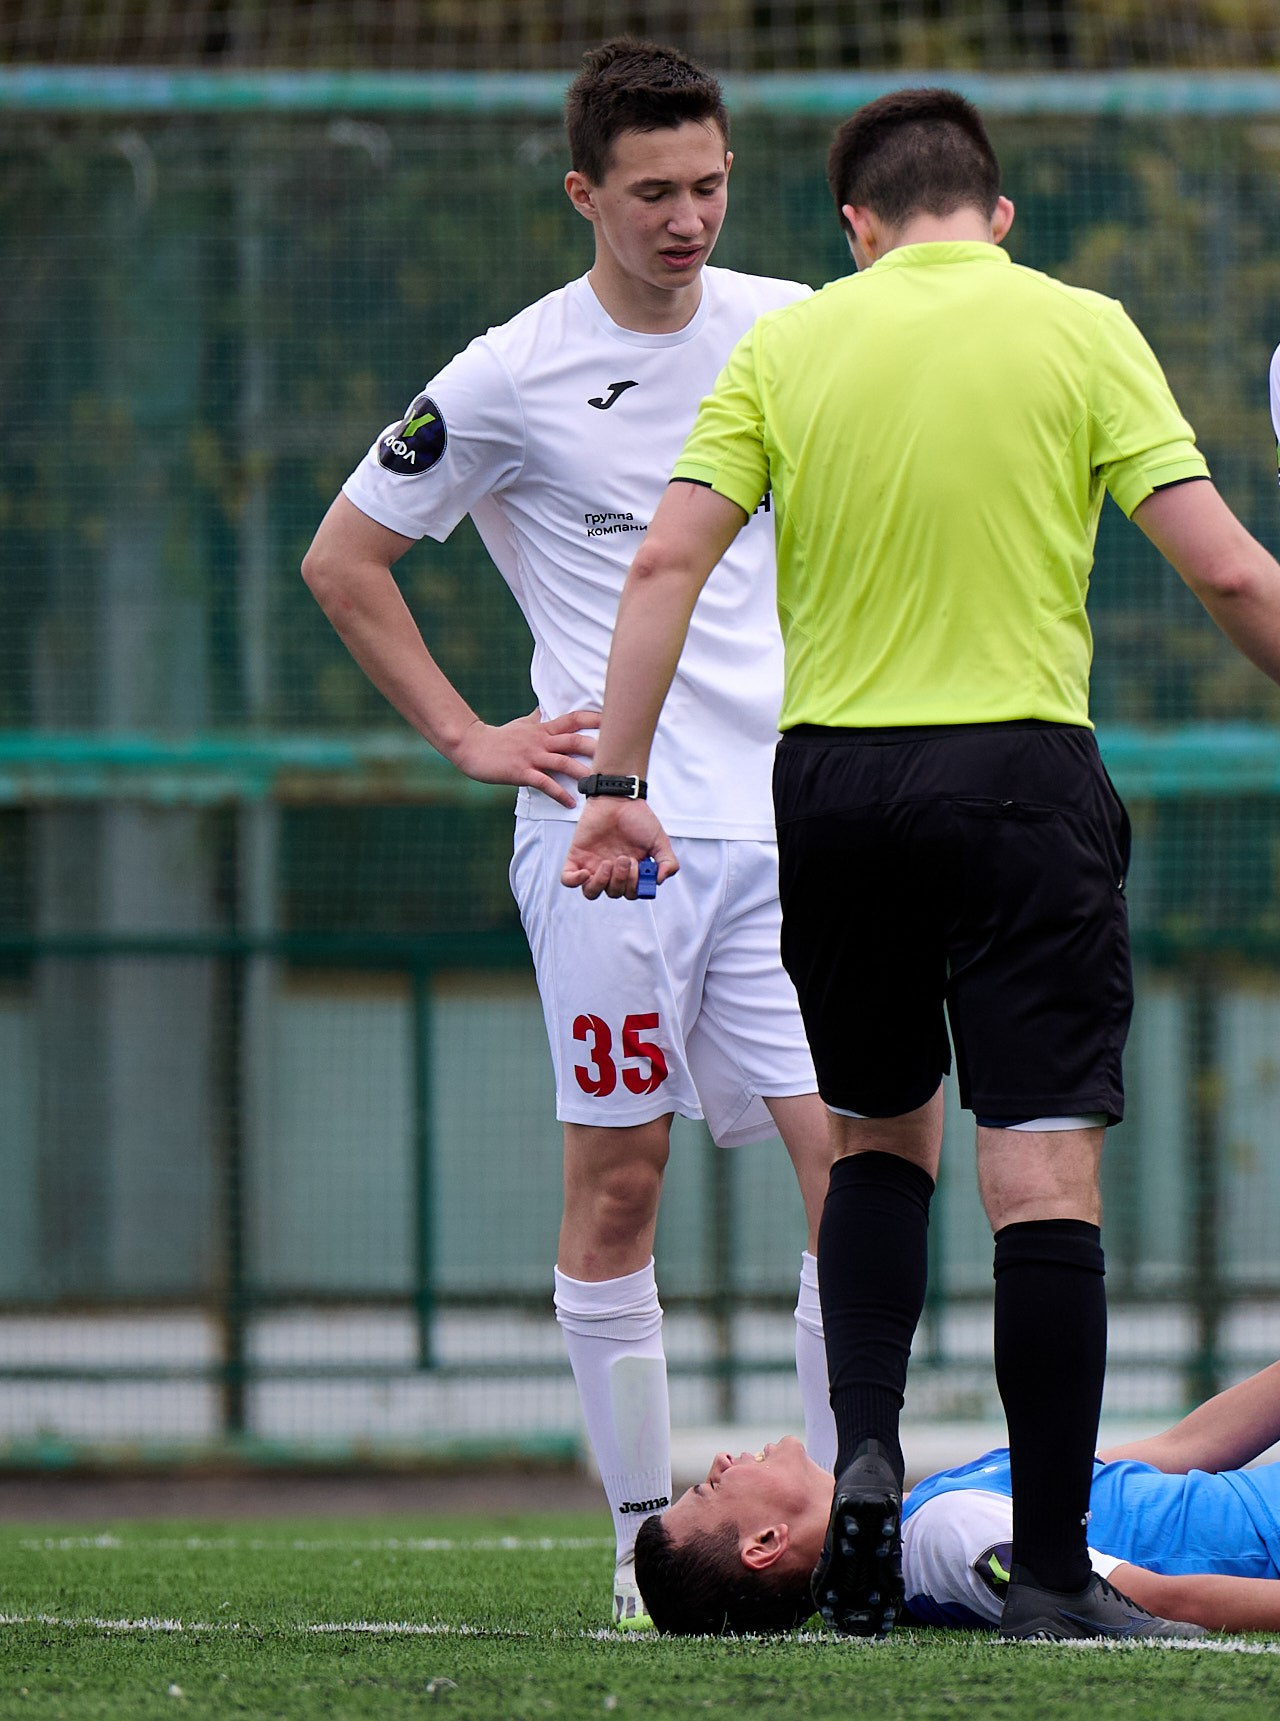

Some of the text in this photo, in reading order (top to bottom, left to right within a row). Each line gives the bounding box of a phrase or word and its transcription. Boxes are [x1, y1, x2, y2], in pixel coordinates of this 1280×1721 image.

[584, 512, 634, 525] Группа
[586, 523, 648, 537] компани
[572, 1012, 669, 1098] 35
[618, 1496, 669, 1514] Joma
